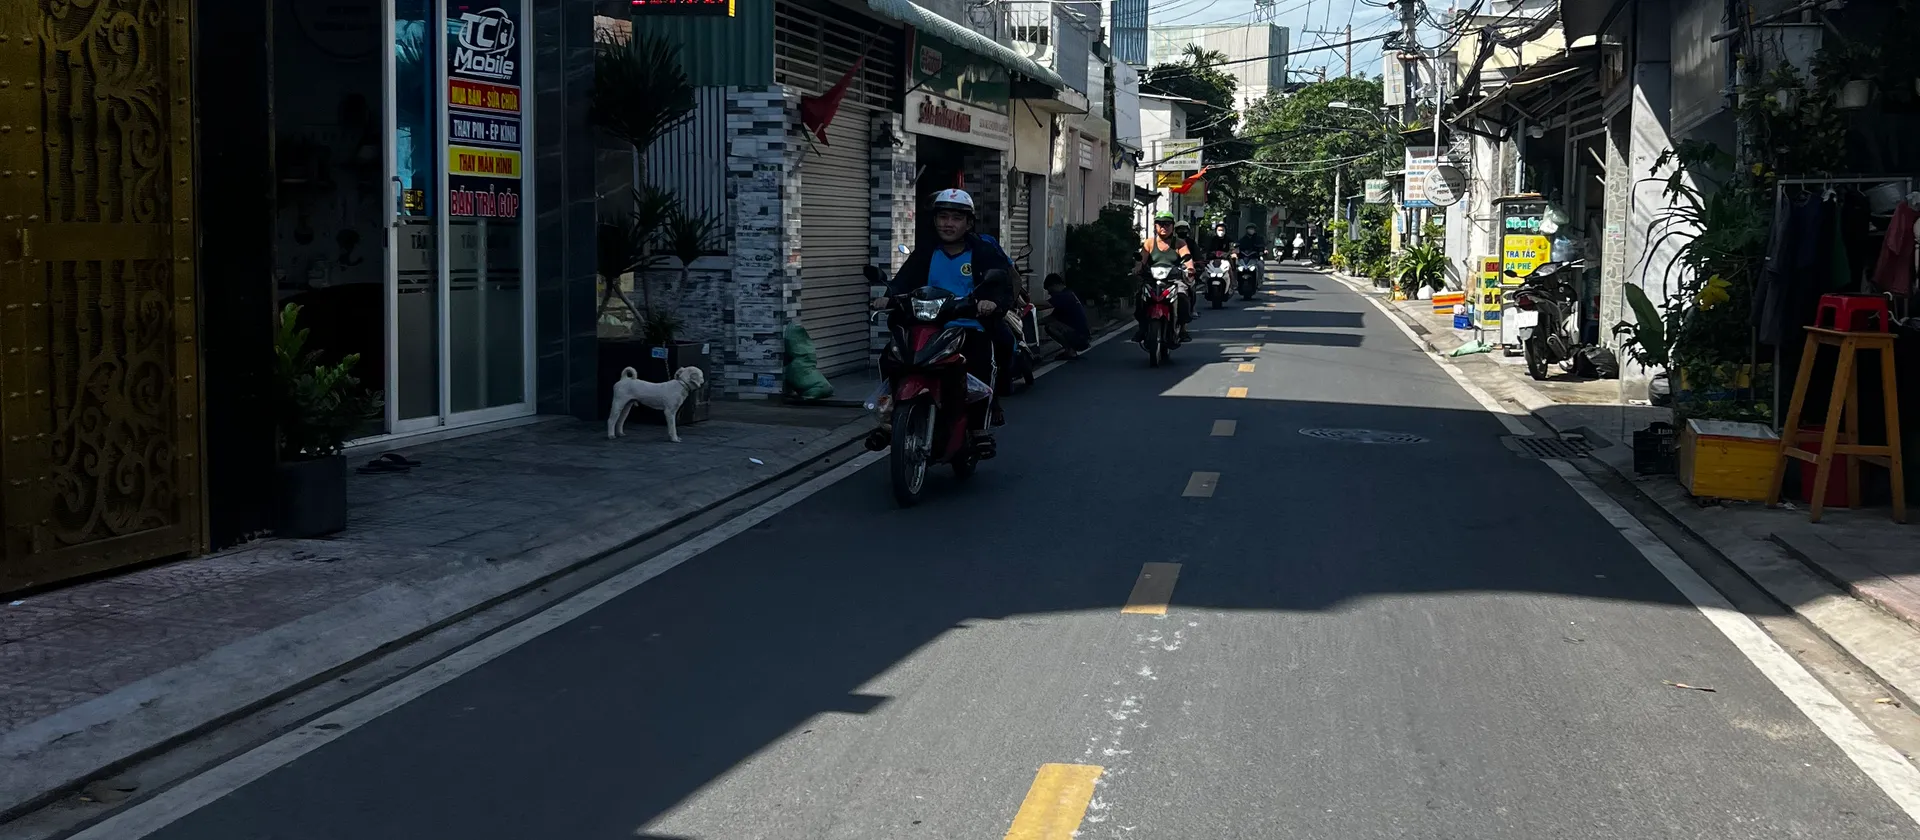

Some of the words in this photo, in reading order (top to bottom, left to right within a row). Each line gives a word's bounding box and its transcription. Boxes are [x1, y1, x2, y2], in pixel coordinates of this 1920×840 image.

[453, 46, 515, 76] Mobile
[453, 119, 471, 139] THAY
[471, 121, 485, 140] PIN
[459, 154, 475, 172] THAY
[478, 152, 494, 173] MÀN
[496, 153, 512, 174] HÌNH
[450, 185, 475, 216] BÁN
[475, 183, 497, 217] TRẢ
[497, 187, 520, 218] GÓP
